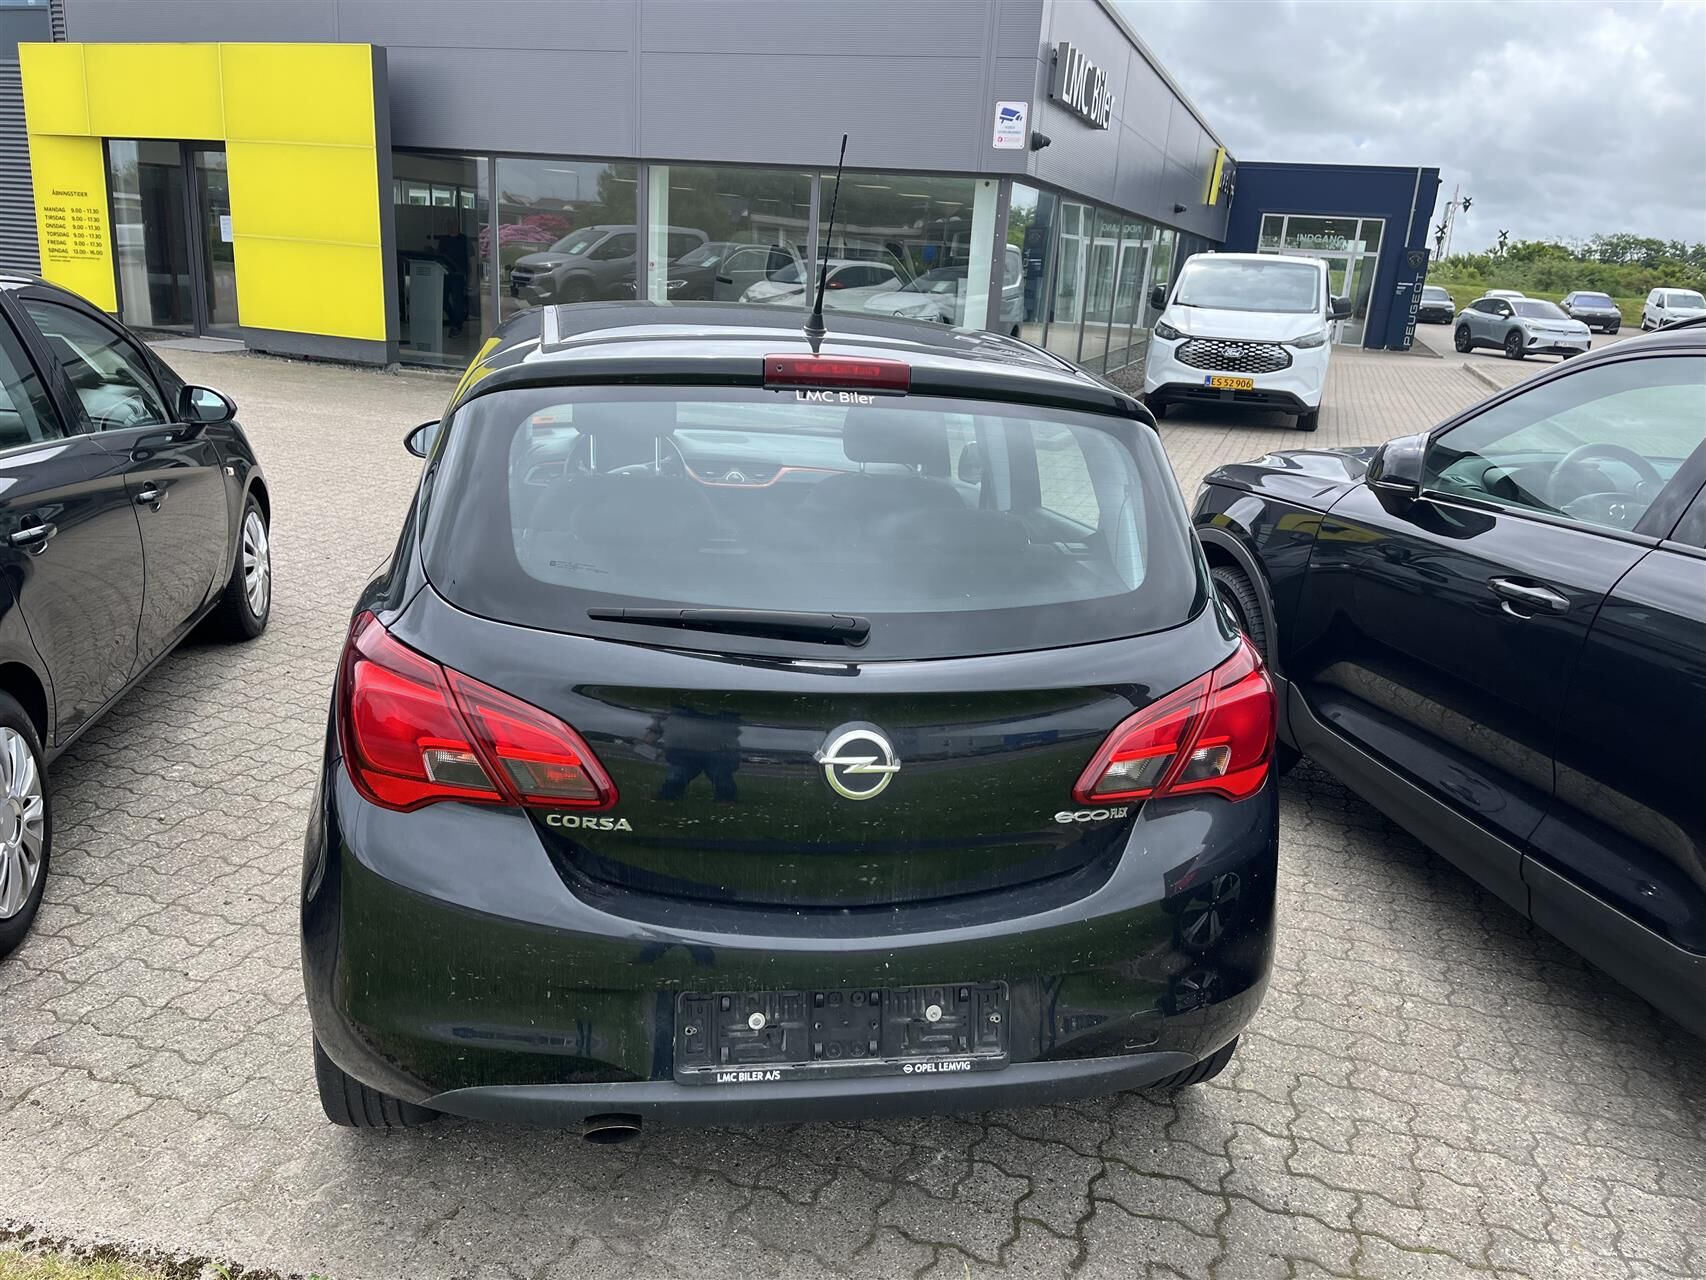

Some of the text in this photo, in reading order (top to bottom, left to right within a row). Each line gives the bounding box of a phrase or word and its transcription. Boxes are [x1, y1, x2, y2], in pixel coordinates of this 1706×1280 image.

[1062, 42, 1116, 130] LMC Biler
[1403, 273, 1424, 346] PEUGEOT
[1211, 377, 1251, 388] ES 52 906
[796, 390, 875, 404] LMC Biler
[546, 814, 633, 831] CORSA
[914, 1061, 971, 1073] OPEL LEMVIG
[717, 1070, 781, 1083] LMC BILER A/S
